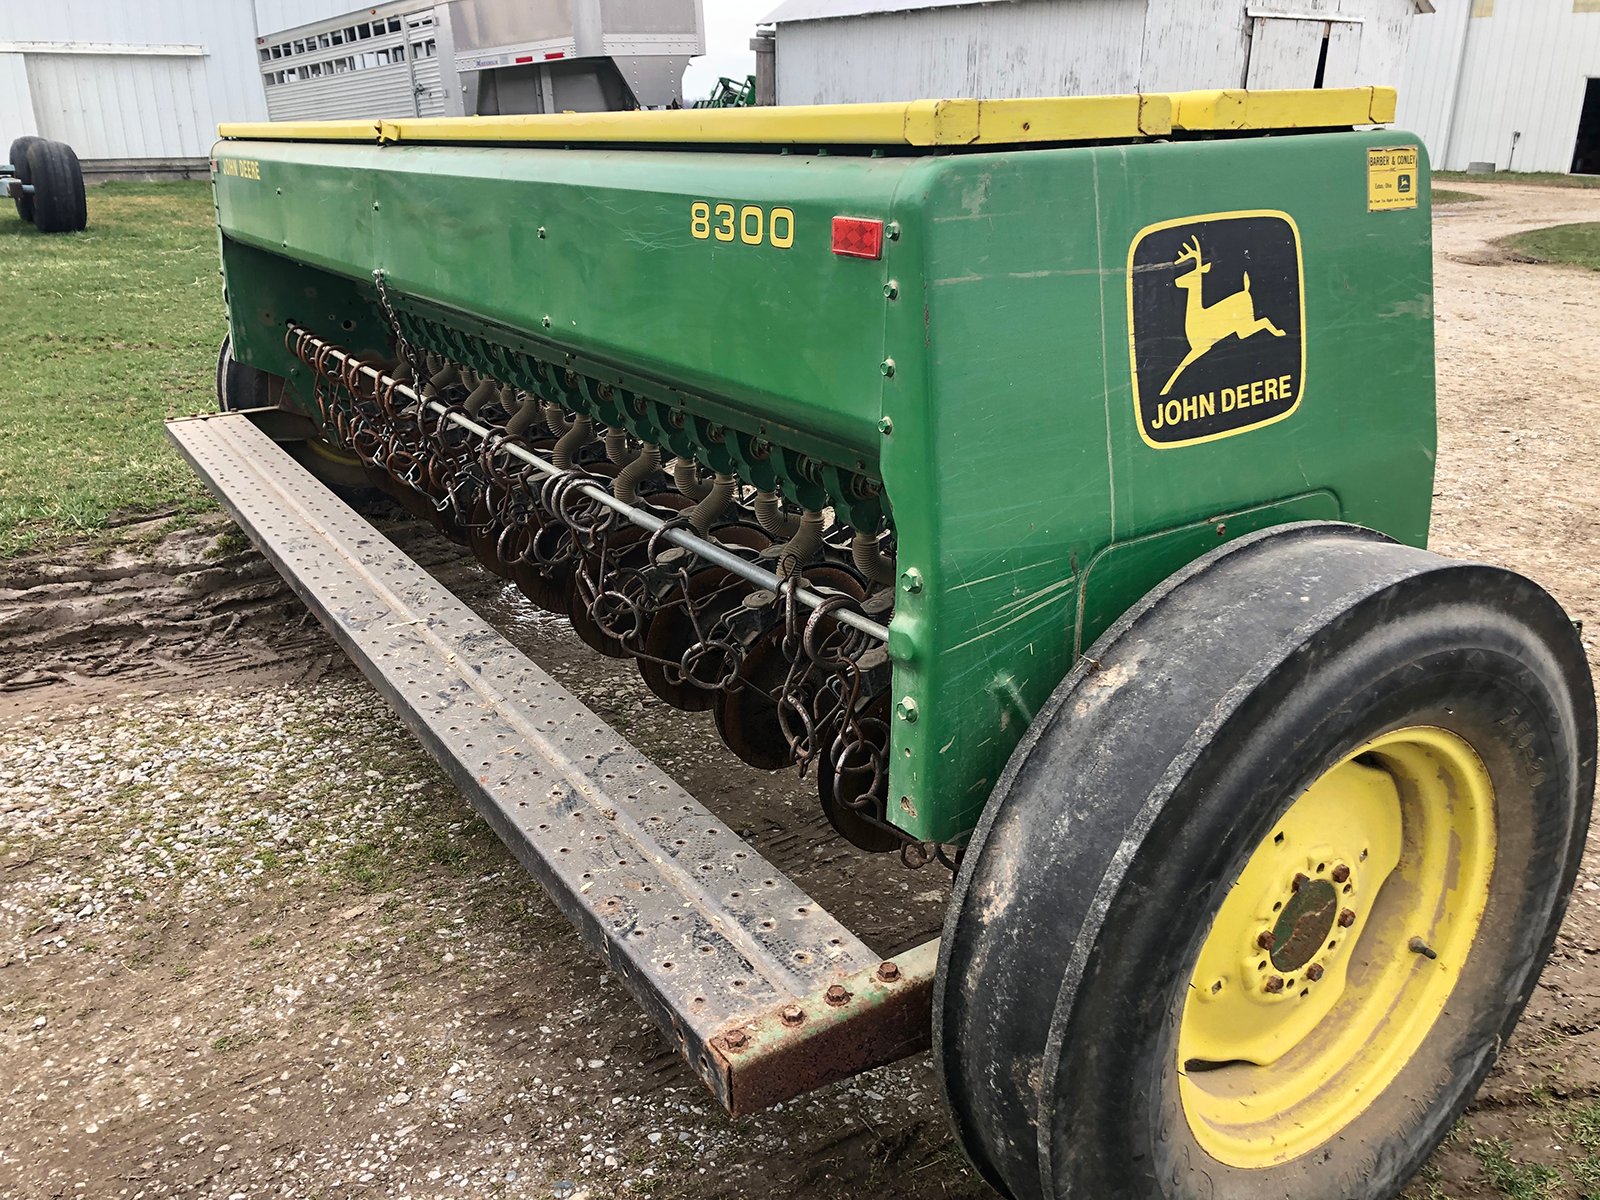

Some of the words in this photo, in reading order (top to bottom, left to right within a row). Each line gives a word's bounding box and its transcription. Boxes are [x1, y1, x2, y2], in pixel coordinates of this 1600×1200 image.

[223, 158, 239, 176] JOHN
[239, 159, 261, 181] DEERE
[1370, 156, 1390, 166] BARBER
[1391, 156, 1396, 165] &
[1397, 155, 1415, 165] CONLEY
[691, 201, 795, 249] 8300
[1151, 392, 1215, 430] JOHN
[1220, 374, 1292, 413] DEERE
